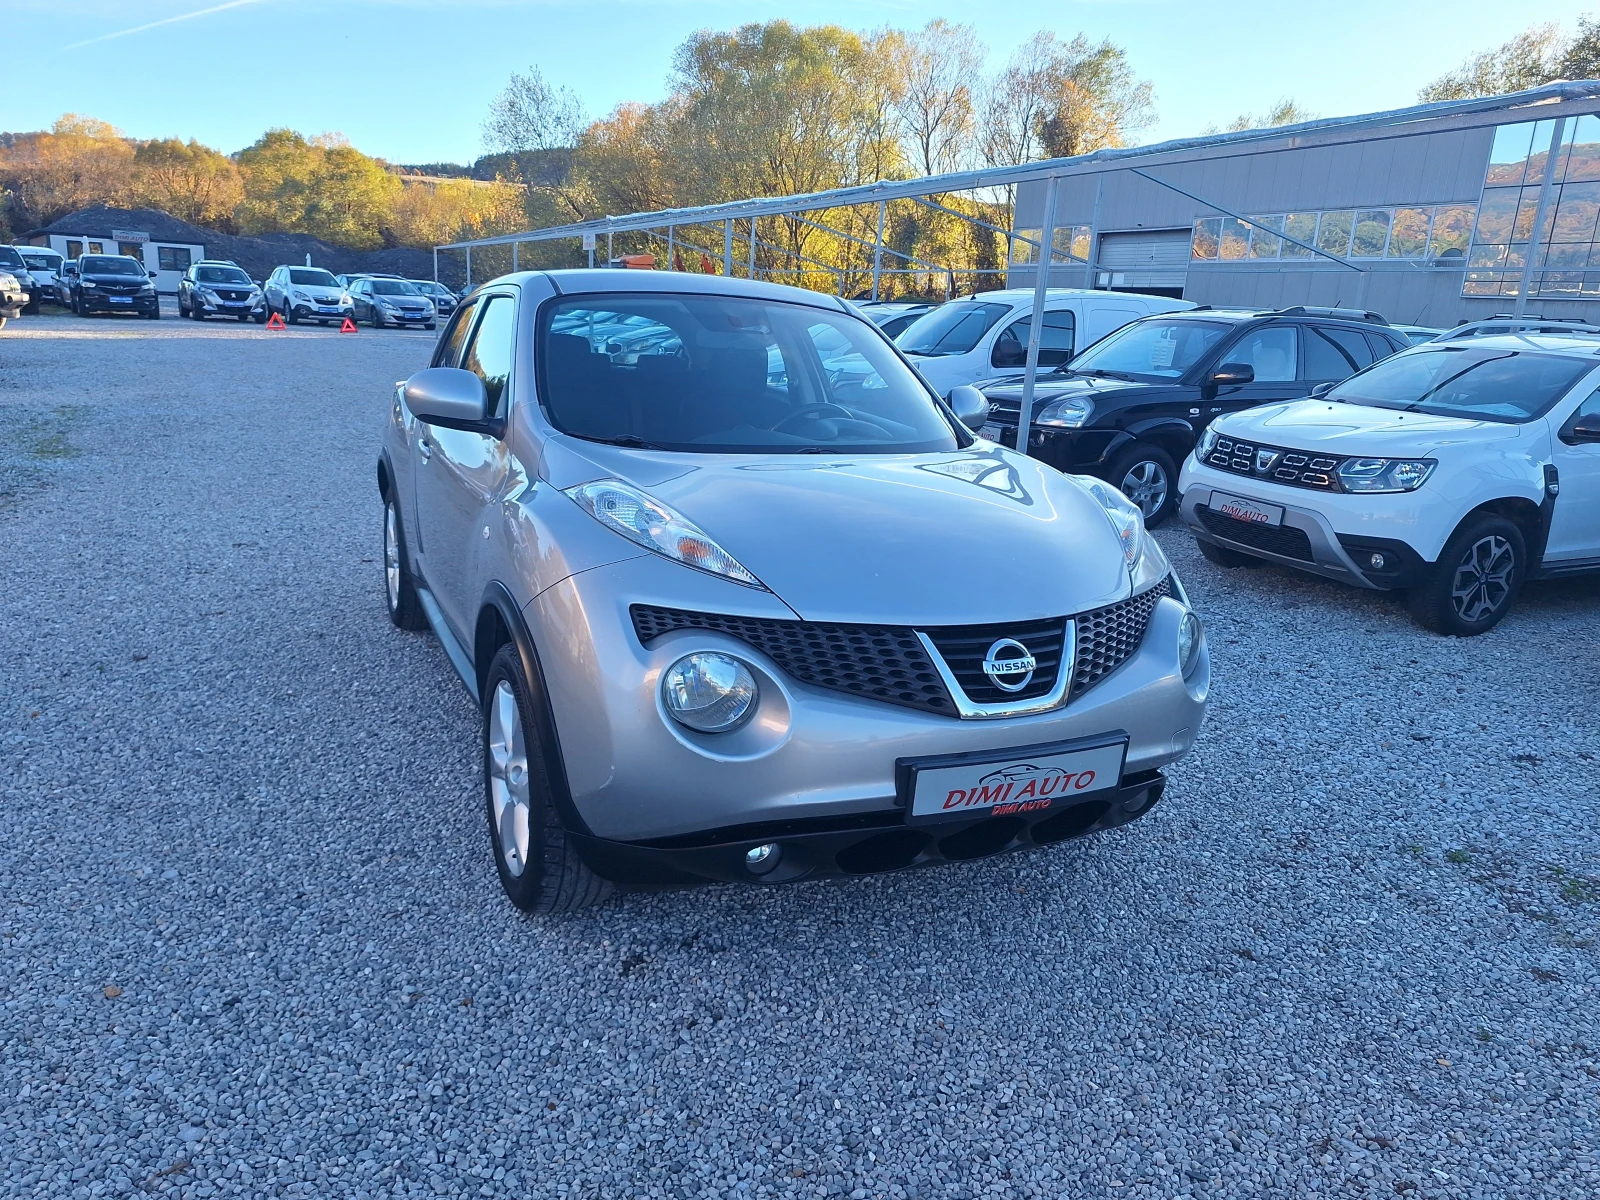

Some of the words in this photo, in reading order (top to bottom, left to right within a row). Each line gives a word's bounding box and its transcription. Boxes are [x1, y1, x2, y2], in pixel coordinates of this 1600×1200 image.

[1221, 503, 1242, 517] DIMI
[1240, 510, 1269, 523] AUTO
[991, 660, 1034, 672] NISSAN
[943, 782, 1014, 809] DIMI
[1014, 770, 1096, 800] AUTO
[991, 802, 1019, 816] DIMI
[1018, 798, 1052, 812] AUTO
